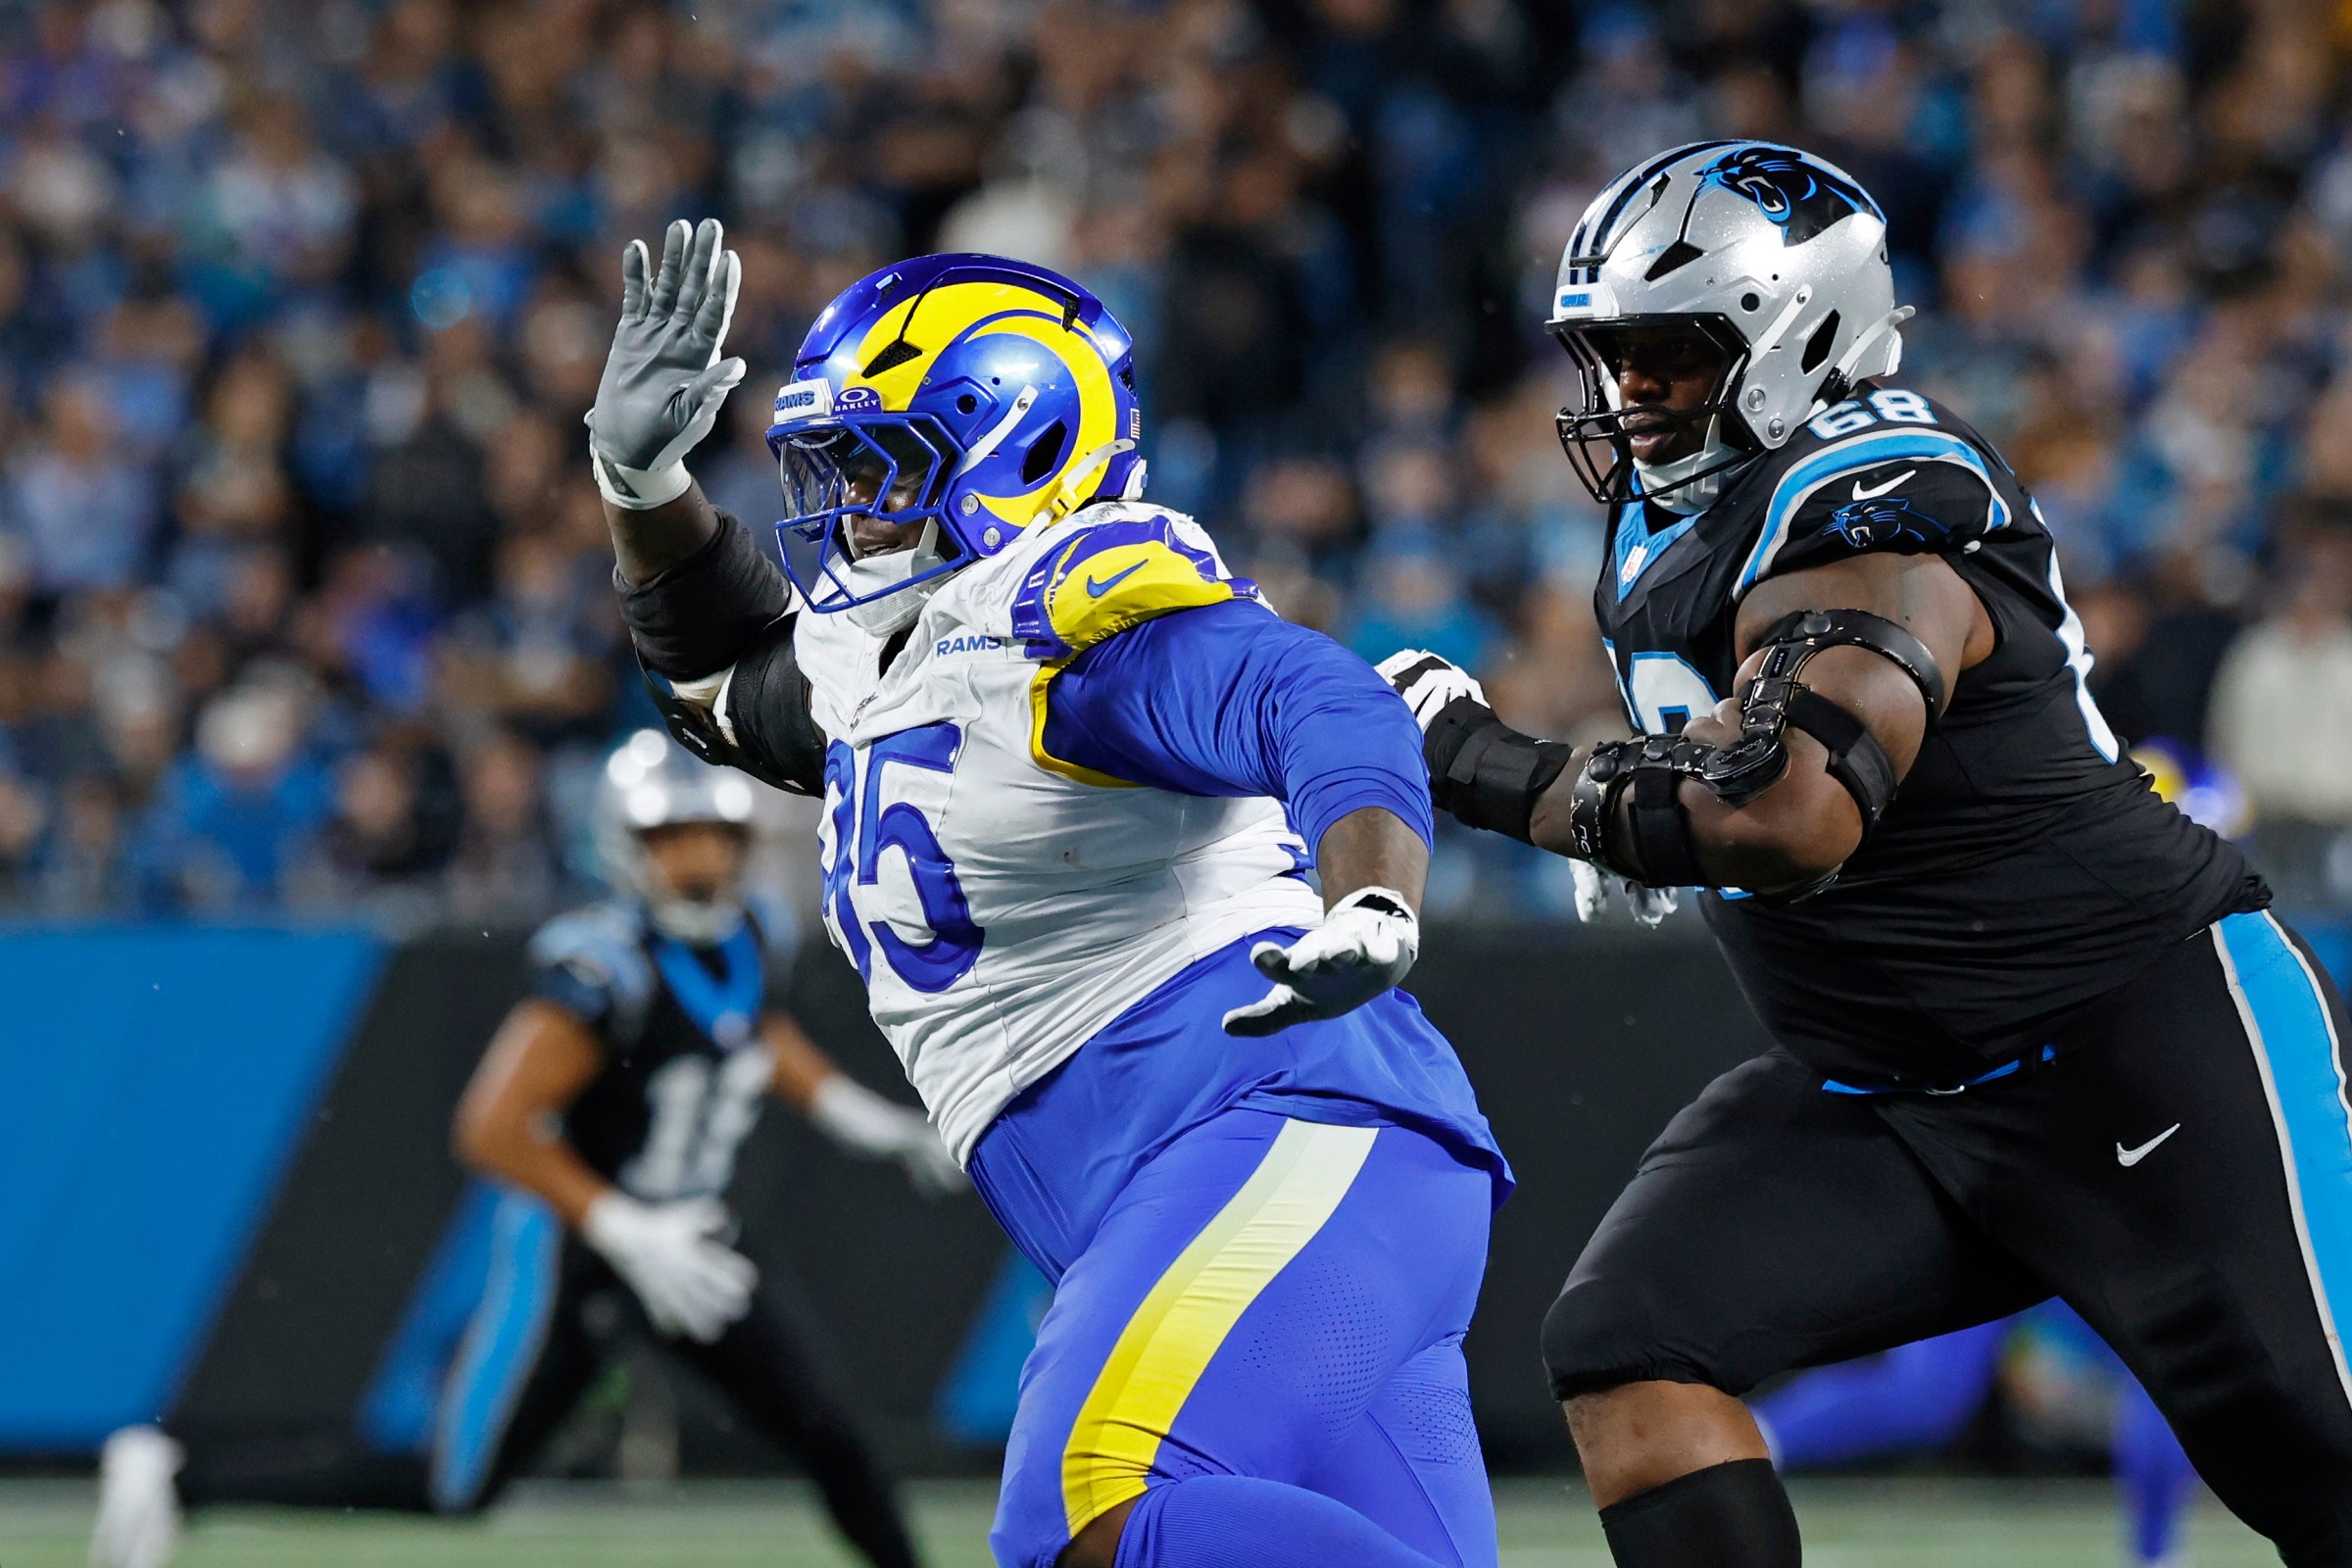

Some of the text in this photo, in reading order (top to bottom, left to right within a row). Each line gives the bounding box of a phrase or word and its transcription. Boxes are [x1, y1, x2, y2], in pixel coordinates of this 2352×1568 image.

[774, 391, 814, 412] RAMS
[835, 399, 878, 412] OAKLEY
[1807, 388, 1939, 440] 68
[937, 635, 1002, 658] RAMS
[817, 720, 985, 993] 95
